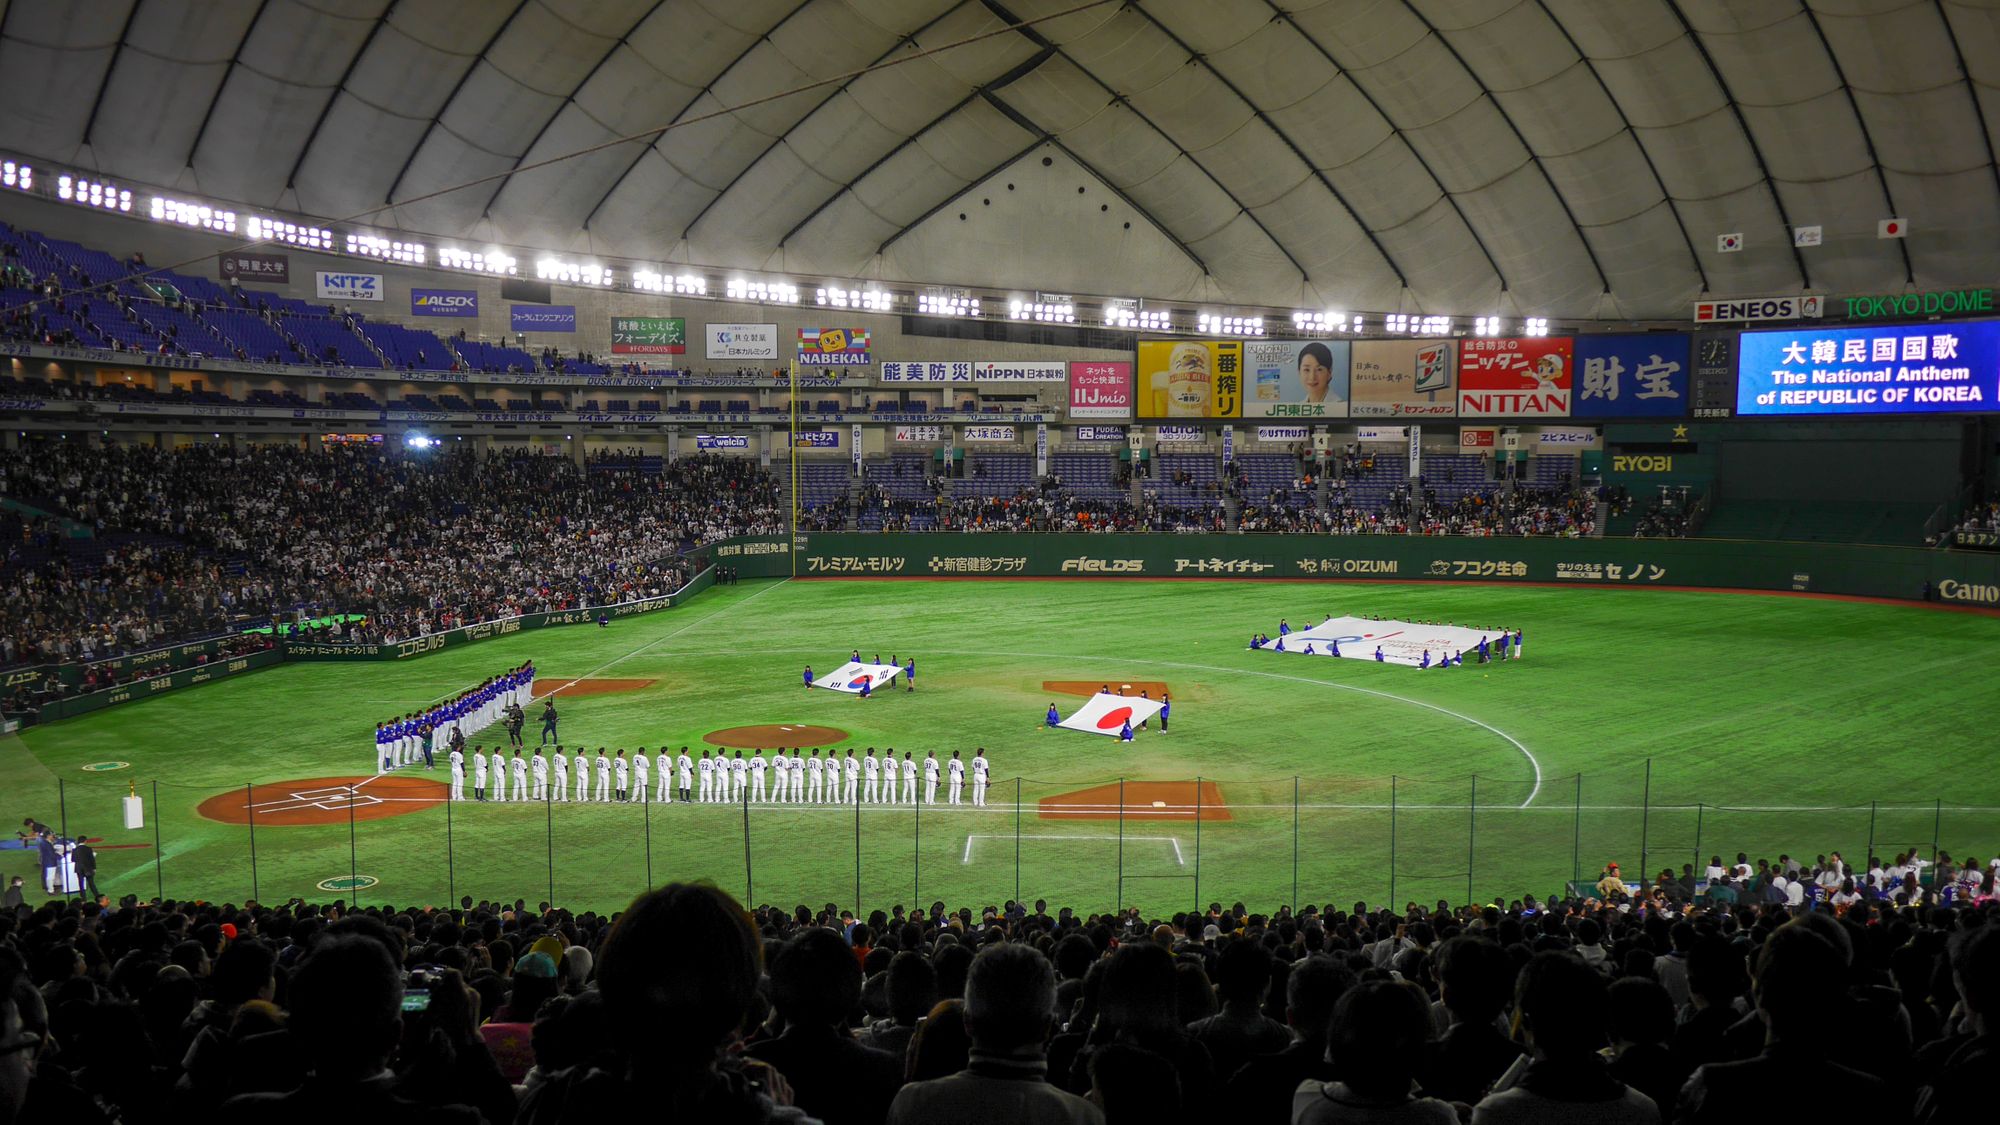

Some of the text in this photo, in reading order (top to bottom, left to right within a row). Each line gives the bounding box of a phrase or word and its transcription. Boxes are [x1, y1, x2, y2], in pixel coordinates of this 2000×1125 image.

[238, 259, 285, 273] 明星大学
[324, 274, 375, 289] KITZ
[428, 296, 474, 307] ALSOK
[1845, 289, 1993, 318] TOKYO DOME
[1716, 300, 1792, 319] ENEOS
[614, 332, 684, 345] フォーデイズ。
[1465, 340, 1518, 351] 総合防災の
[1782, 333, 1958, 365] 大韓民国国歌
[800, 353, 868, 364] NABEKAI.
[1463, 353, 1528, 370] ニッタン
[884, 363, 969, 380] 能美防災
[1027, 369, 1064, 379] 日本製粉
[1086, 367, 1115, 375] ネットを
[1581, 354, 1681, 401] 財宝
[1771, 366, 1970, 385] The National Anthem
[587, 377, 663, 387] DUSKIN DUSKIN
[774, 379, 842, 387] パラウントベッド
[1078, 376, 1124, 384] もっと快適に
[1217, 343, 1238, 416] 一番搾り
[1074, 388, 1127, 404] IIJmio
[1756, 386, 1982, 405] of REPUBLIC OF KOREA
[1265, 404, 1325, 417] JR東日本
[1462, 394, 1566, 413] NITTAN
[805, 432, 834, 441] ビヒダス
[965, 428, 1014, 439] 大塚商会
[1268, 429, 1308, 438] USTRUST
[716, 437, 745, 446] welcia
[1131, 437, 1140, 445] 14
[1613, 456, 1672, 472] RYOBI
[770, 543, 789, 553] 免震
[807, 557, 905, 571] プレミアム・モルツ
[943, 556, 1027, 572] 新宿健診プラザ
[1174, 557, 1274, 573] アートネイチャー
[1343, 559, 1398, 573] OIZUMI
[1453, 560, 1528, 577] フコク生命
[1556, 562, 1603, 572] 守りの名手
[1605, 562, 1666, 580] セノン
[1938, 579, 2000, 604] Cano
[500, 621, 521, 634] XEBEC
[288, 646, 315, 655] スパラクーア
[397, 634, 445, 658] コニカミノルタ
